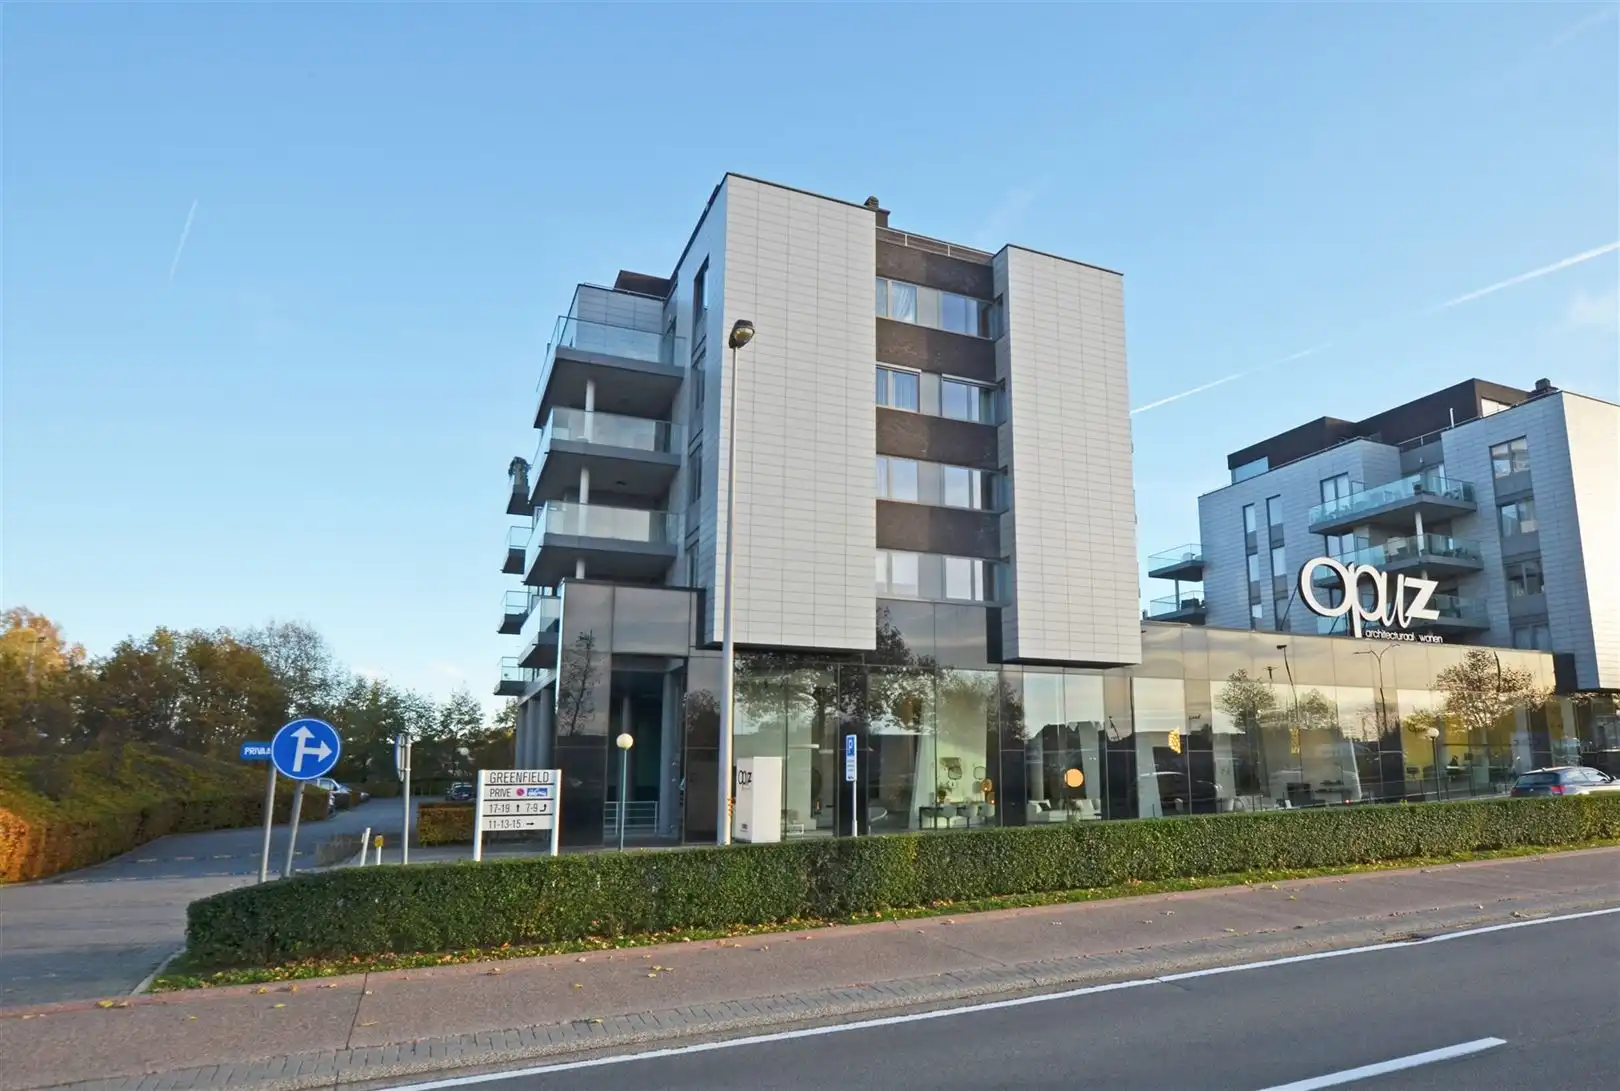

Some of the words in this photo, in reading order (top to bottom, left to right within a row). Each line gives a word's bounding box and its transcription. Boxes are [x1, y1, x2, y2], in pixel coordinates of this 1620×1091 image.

[489, 771, 549, 784] GREENFIELD
[489, 788, 511, 797] PRIVE
[489, 803, 510, 813] 17-19
[526, 802, 538, 813] 7-9
[488, 819, 521, 829] 11-13-15
